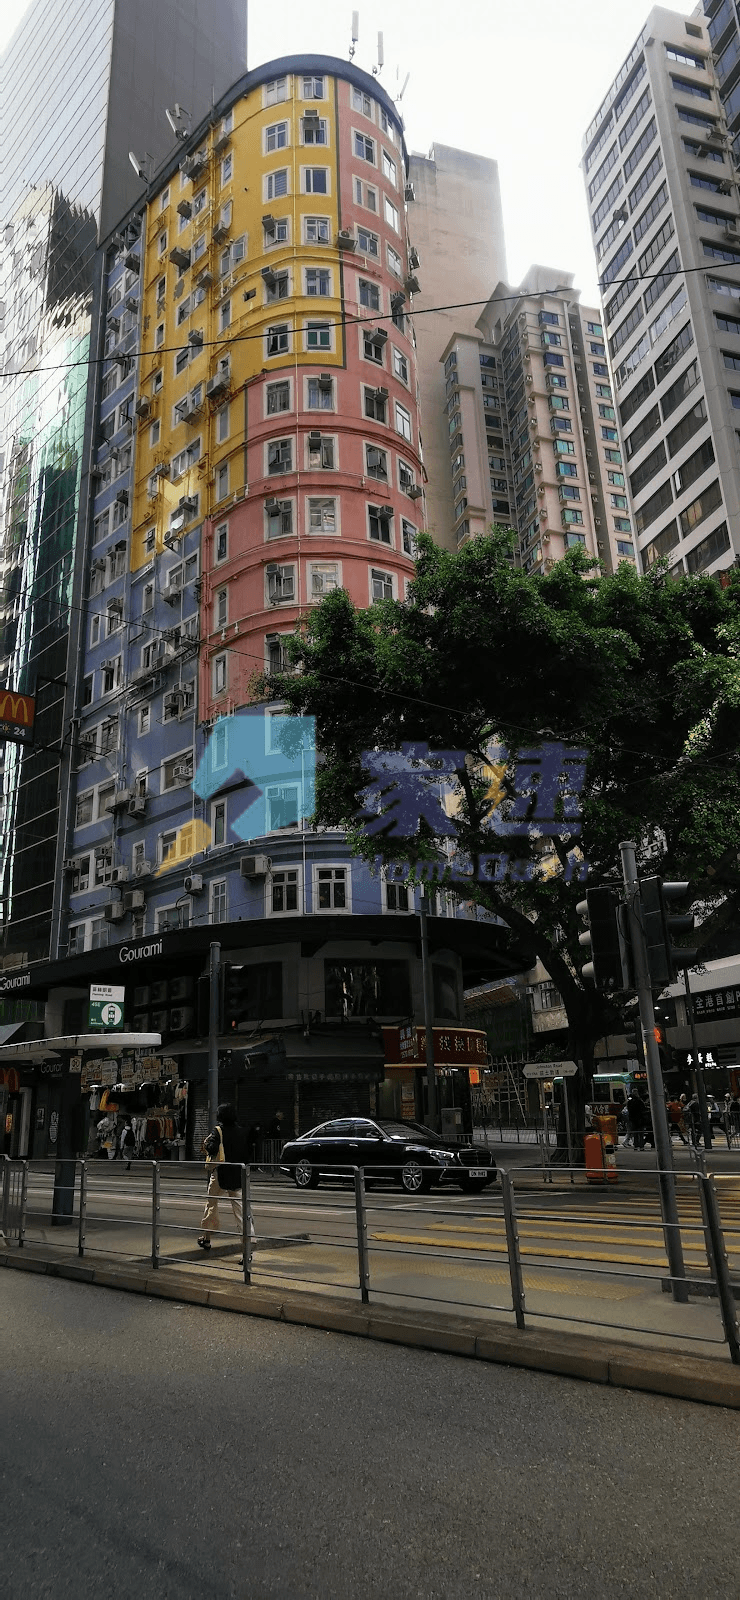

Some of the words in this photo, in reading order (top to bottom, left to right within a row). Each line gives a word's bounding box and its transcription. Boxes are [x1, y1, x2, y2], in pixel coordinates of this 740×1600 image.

[13, 726, 26, 737] 24
[119, 939, 163, 963] Gourami
[0, 972, 31, 991] Gourami
